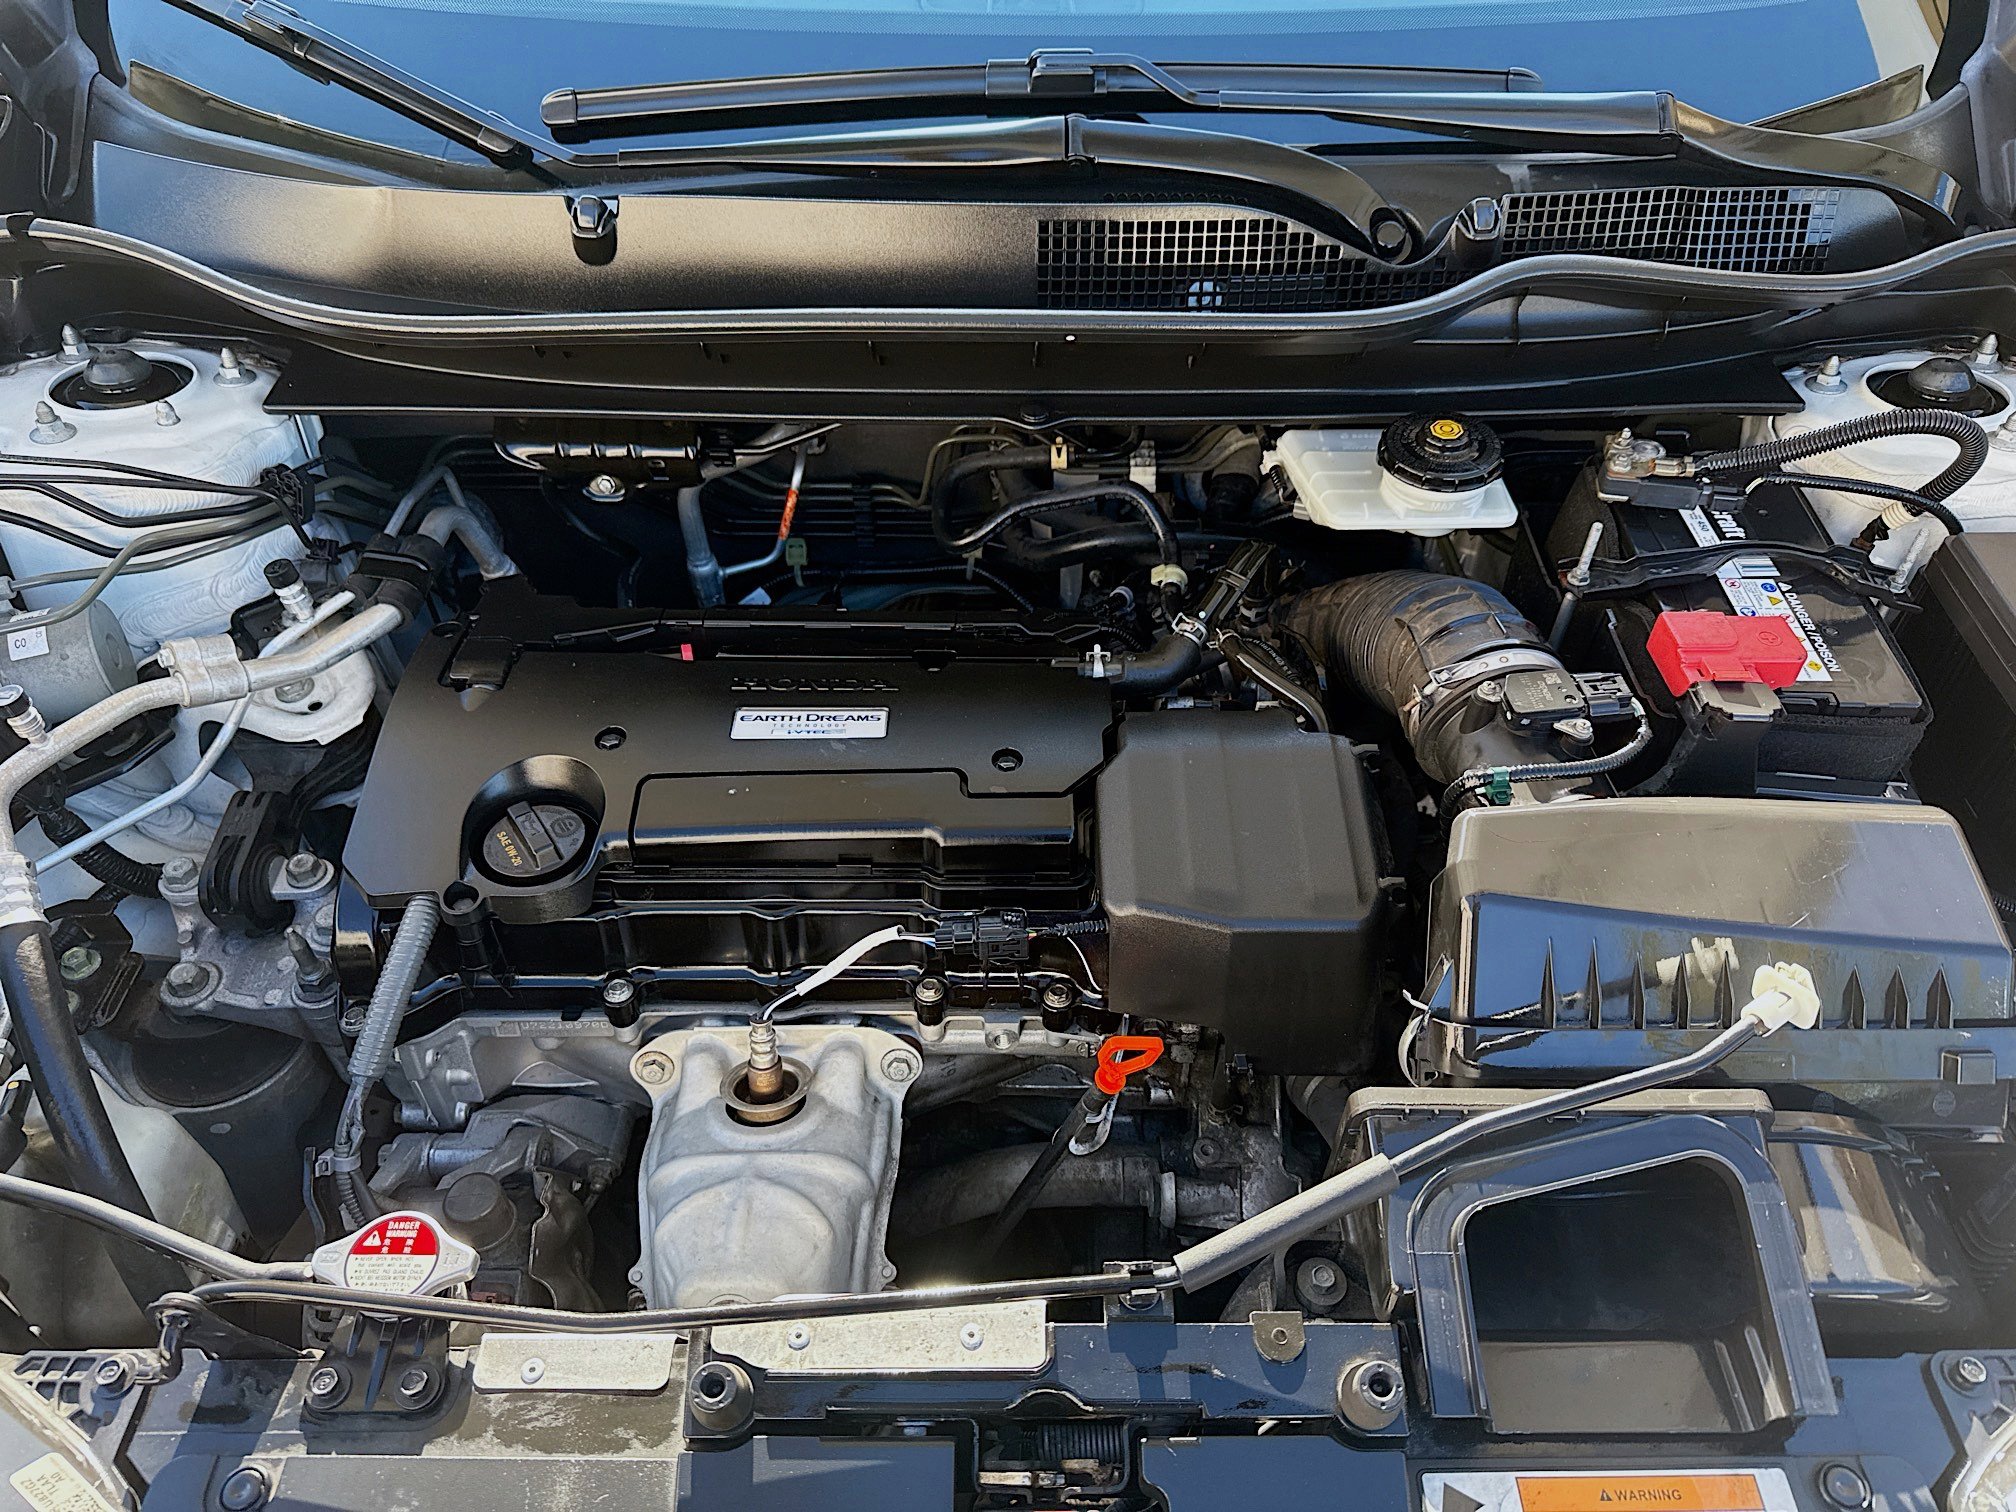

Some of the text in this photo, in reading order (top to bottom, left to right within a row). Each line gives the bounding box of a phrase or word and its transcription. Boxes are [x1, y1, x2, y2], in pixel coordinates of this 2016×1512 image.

[1431, 501, 1456, 511] MAX
[731, 678, 900, 691] HONDA
[806, 714, 881, 722] DREAMS
[496, 831, 512, 847] SAE
[388, 1221, 420, 1230] DANGER
[1614, 1489, 1682, 1501] WARNING
